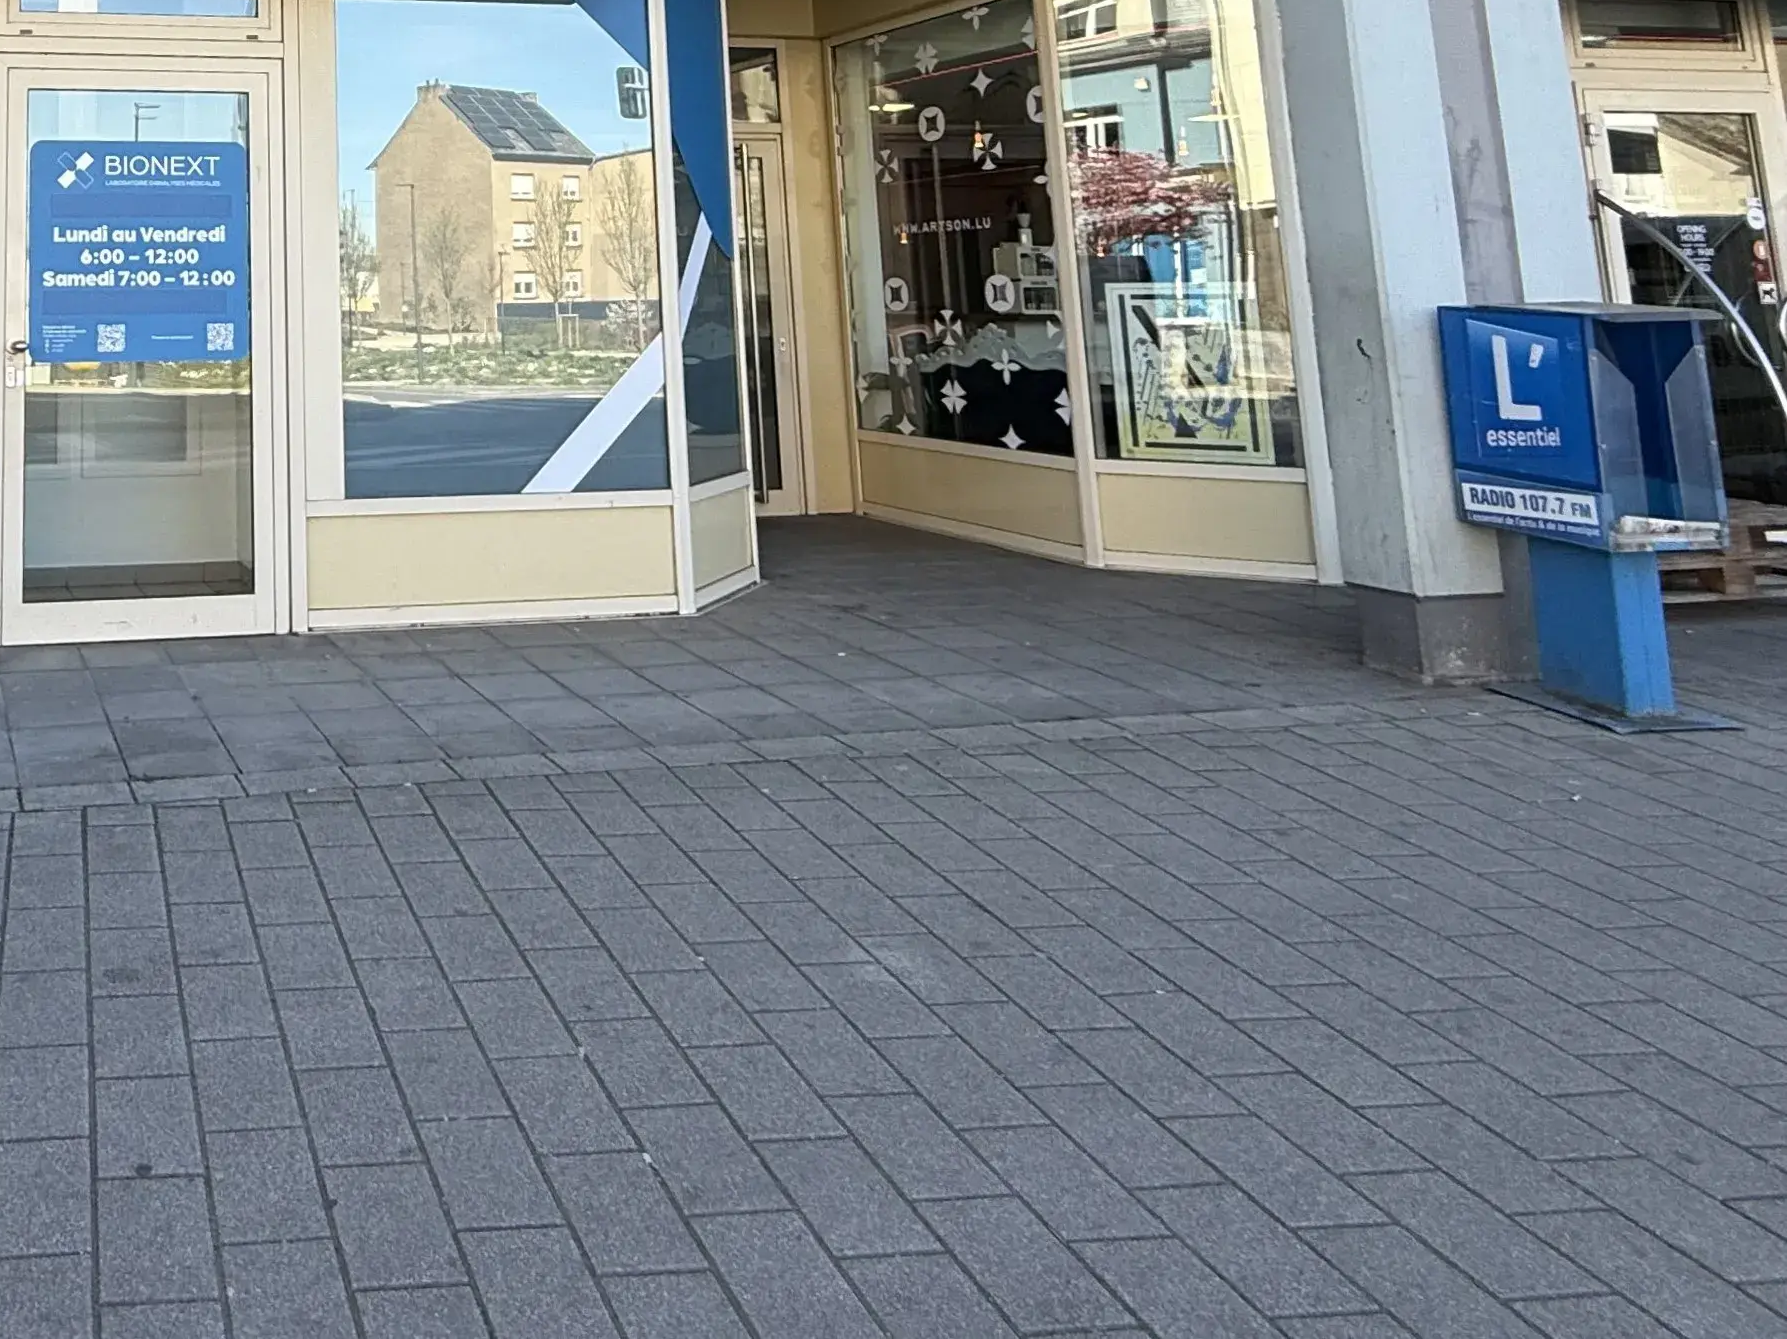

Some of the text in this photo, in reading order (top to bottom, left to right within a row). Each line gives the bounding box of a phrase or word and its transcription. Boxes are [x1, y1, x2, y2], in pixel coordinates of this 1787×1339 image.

[104, 155, 221, 176] BIONEXT
[53, 224, 226, 243] Lundi au Vendredi
[80, 248, 125, 265] 6:00
[144, 248, 199, 265] 12:00
[42, 269, 114, 286] Samedi
[117, 270, 162, 287] 7:00
[1491, 334, 1544, 421] L'
[1486, 426, 1561, 447] essentiel
[1470, 486, 1593, 519] RADIO 107.7 FM
